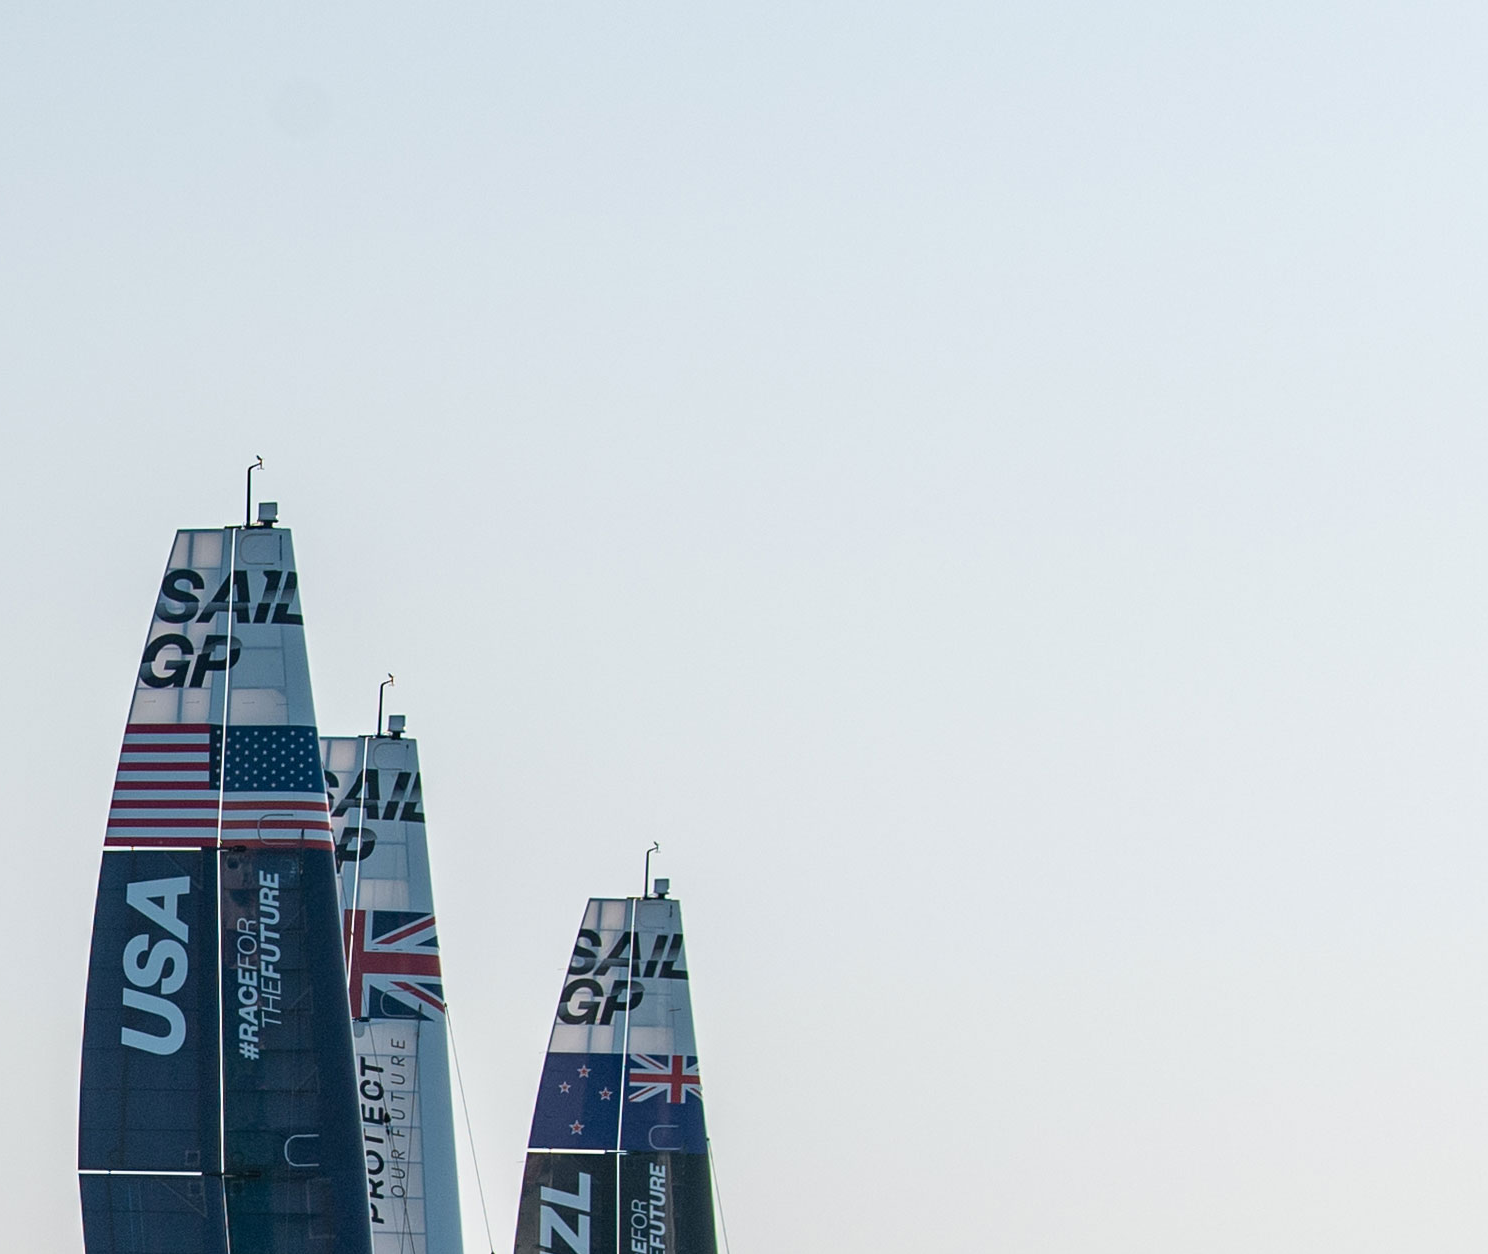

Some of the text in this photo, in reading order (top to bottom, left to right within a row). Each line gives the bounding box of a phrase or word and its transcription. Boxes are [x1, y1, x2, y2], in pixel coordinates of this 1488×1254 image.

[155, 569, 304, 625] SAIL
[138, 633, 243, 689] GP
[121, 875, 191, 1056] USA
[236, 916, 260, 1061] #RACEFOR
[259, 870, 282, 1029] THEFUTURE
[567, 928, 689, 980] SAIL
[556, 978, 646, 1026] GP
[391, 1038, 406, 1198] OUR FUTURE
